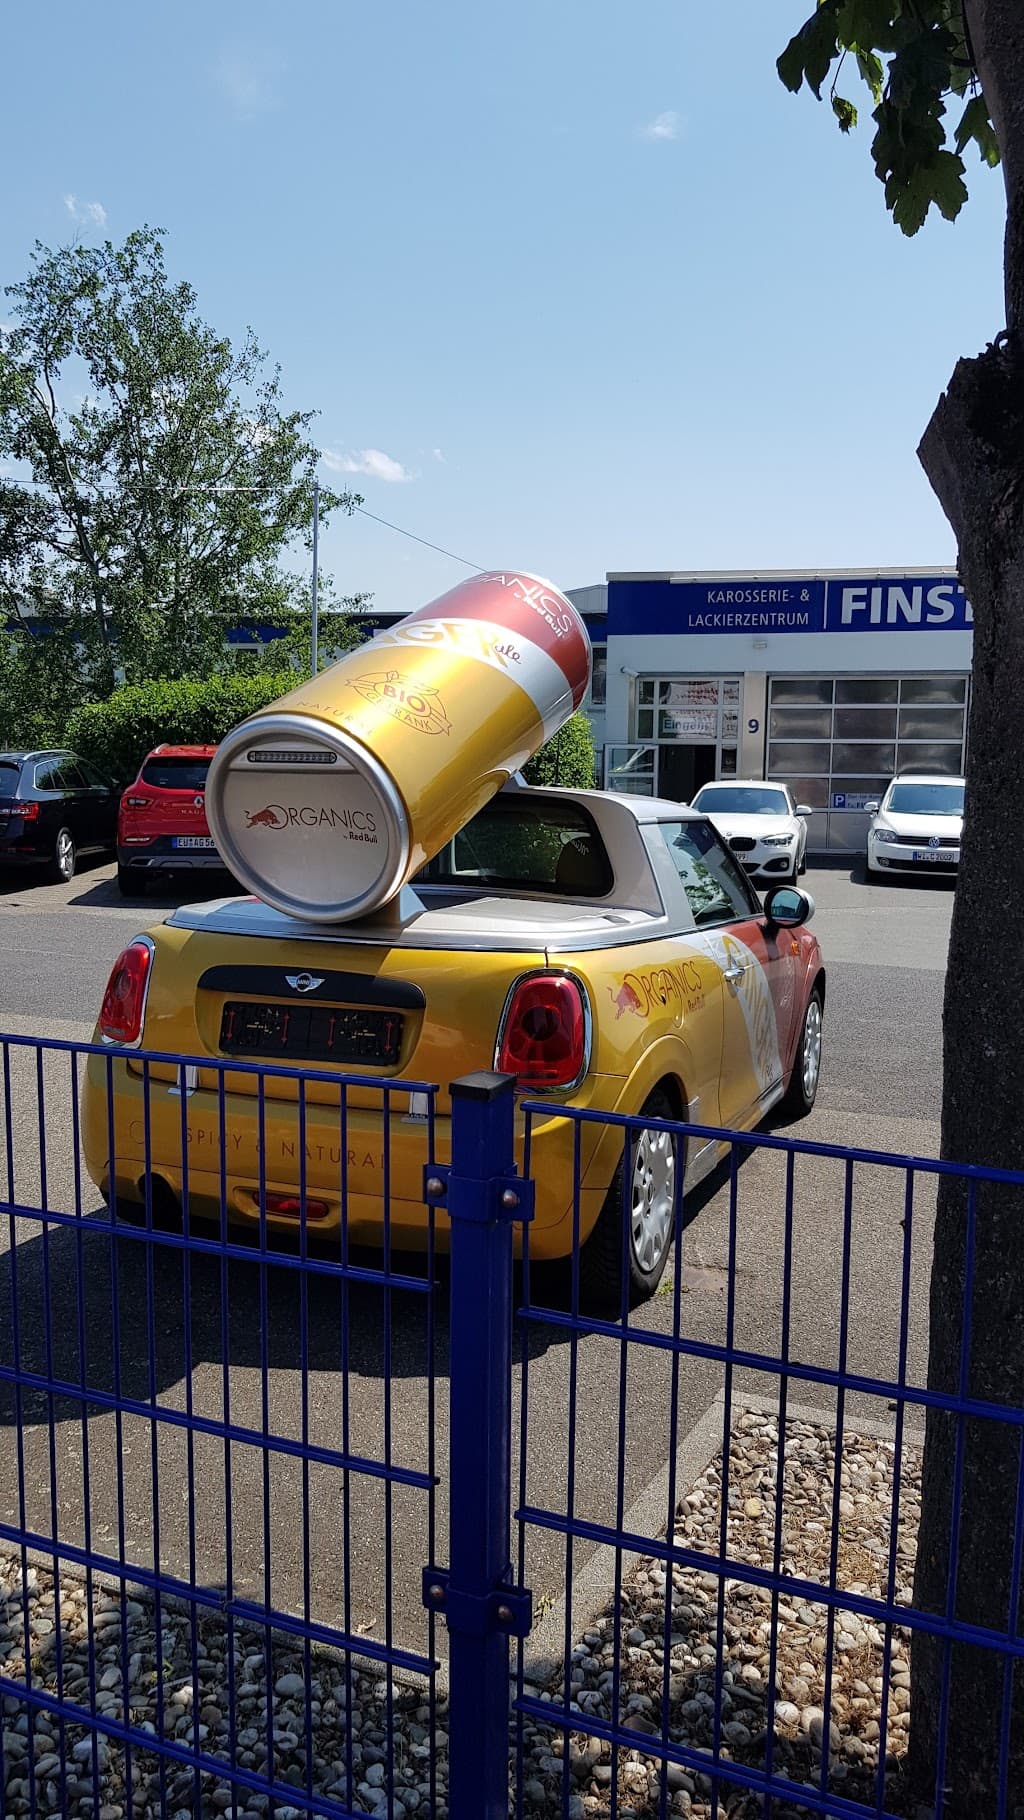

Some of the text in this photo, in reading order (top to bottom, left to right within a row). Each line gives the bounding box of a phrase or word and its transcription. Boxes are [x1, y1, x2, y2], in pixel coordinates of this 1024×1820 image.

[707, 589, 810, 604] KAROSSERIE- &
[688, 612, 810, 628] LACKIERZENTRUM
[383, 684, 426, 712] BIO
[748, 718, 760, 734] 9
[835, 795, 844, 806] P
[263, 804, 376, 832] ORGANICS
[349, 831, 364, 842] Red
[364, 834, 378, 844] Bull
[624, 960, 702, 1017] ORGANICS
